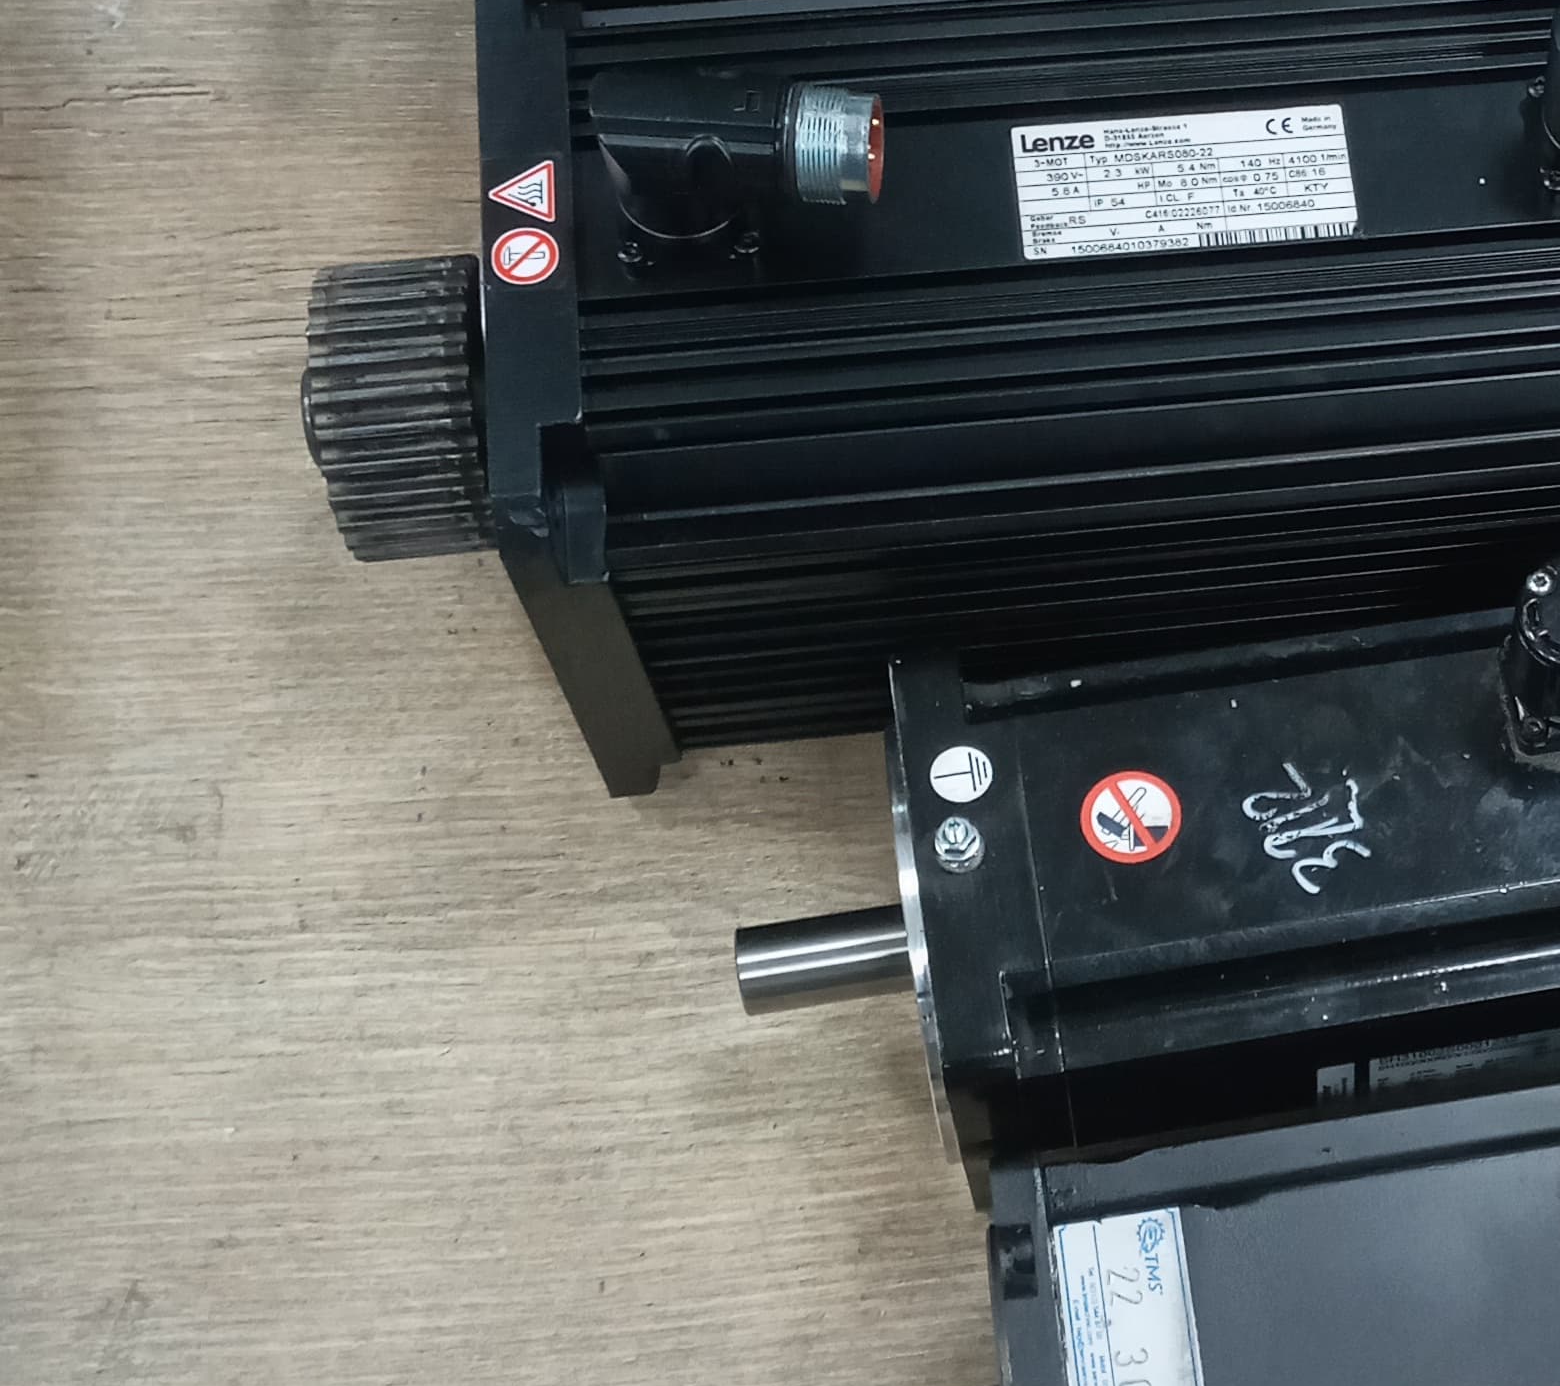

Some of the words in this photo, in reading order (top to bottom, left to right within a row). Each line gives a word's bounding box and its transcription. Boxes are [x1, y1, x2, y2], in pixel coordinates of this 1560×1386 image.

[1302, 123, 1336, 131] Germany
[1020, 133, 1095, 153] Lenze
[1034, 157, 1068, 168] 3-MOT
[1090, 155, 1108, 166] Typ
[1114, 147, 1213, 163] MDSKARS080-22
[1046, 172, 1069, 182] 390
[1135, 167, 1150, 175] kW
[1200, 162, 1216, 171] Nm
[1240, 158, 1262, 168] 140
[1268, 157, 1280, 165] Hz
[1288, 154, 1317, 165] 4100
[1321, 152, 1346, 161] 1/min
[1072, 186, 1080, 195] A
[1137, 181, 1150, 190] HP
[1201, 176, 1218, 185] Nm
[1312, 167, 1326, 177] 16
[1110, 197, 1125, 207] 54
[1187, 192, 1195, 201] F
[1253, 186, 1277, 196] 40°C
[1304, 182, 1328, 192] KTY
[1068, 215, 1086, 225] RS
[1258, 199, 1315, 212] 15006840
[1158, 224, 1165, 233] A
[1196, 222, 1212, 230] Nm
[1034, 247, 1047, 255] SN
[1144, 1253, 1163, 1293] TMS
